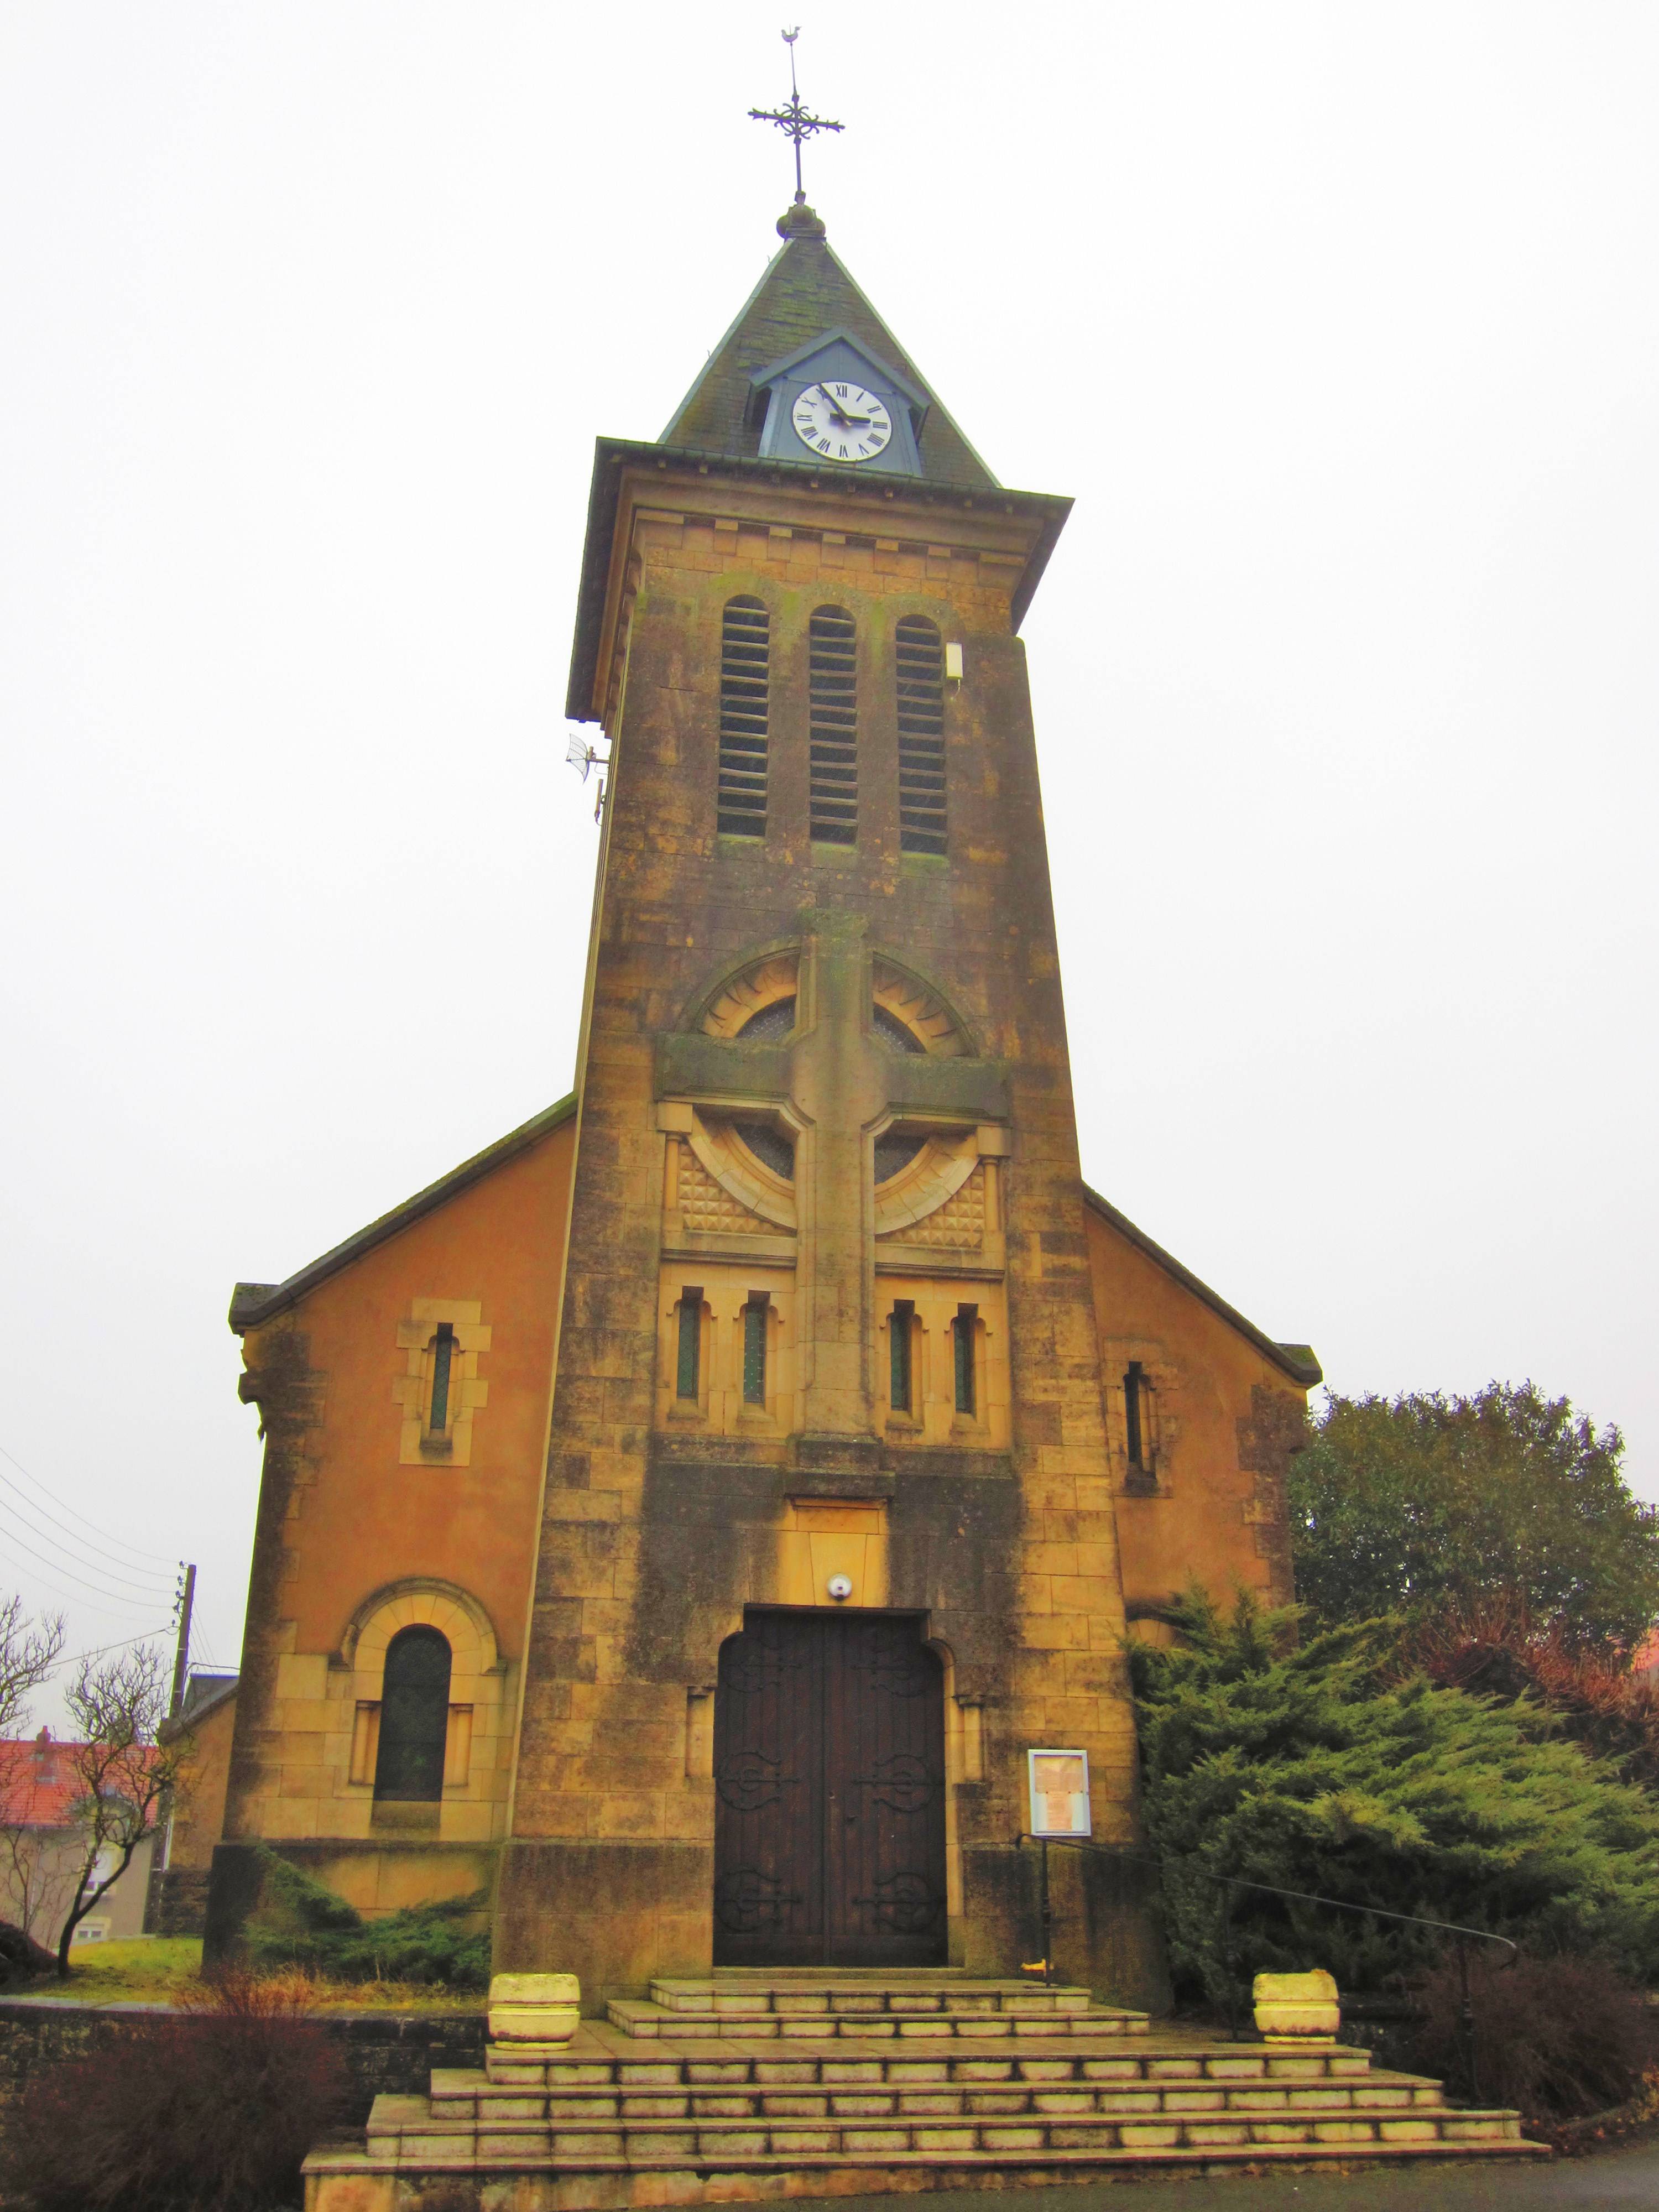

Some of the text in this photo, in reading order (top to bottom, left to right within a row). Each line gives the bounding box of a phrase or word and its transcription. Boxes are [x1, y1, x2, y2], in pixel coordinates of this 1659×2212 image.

[836, 384, 847, 398] XII
[856, 392, 864, 402] I
[801, 397, 817, 408] X
[867, 405, 881, 414] II
[797, 413, 812, 421] IX
[801, 426, 818, 440] VIII
[817, 438, 831, 452] VII
[858, 444, 869, 456] V
[839, 445, 848, 458] VI
